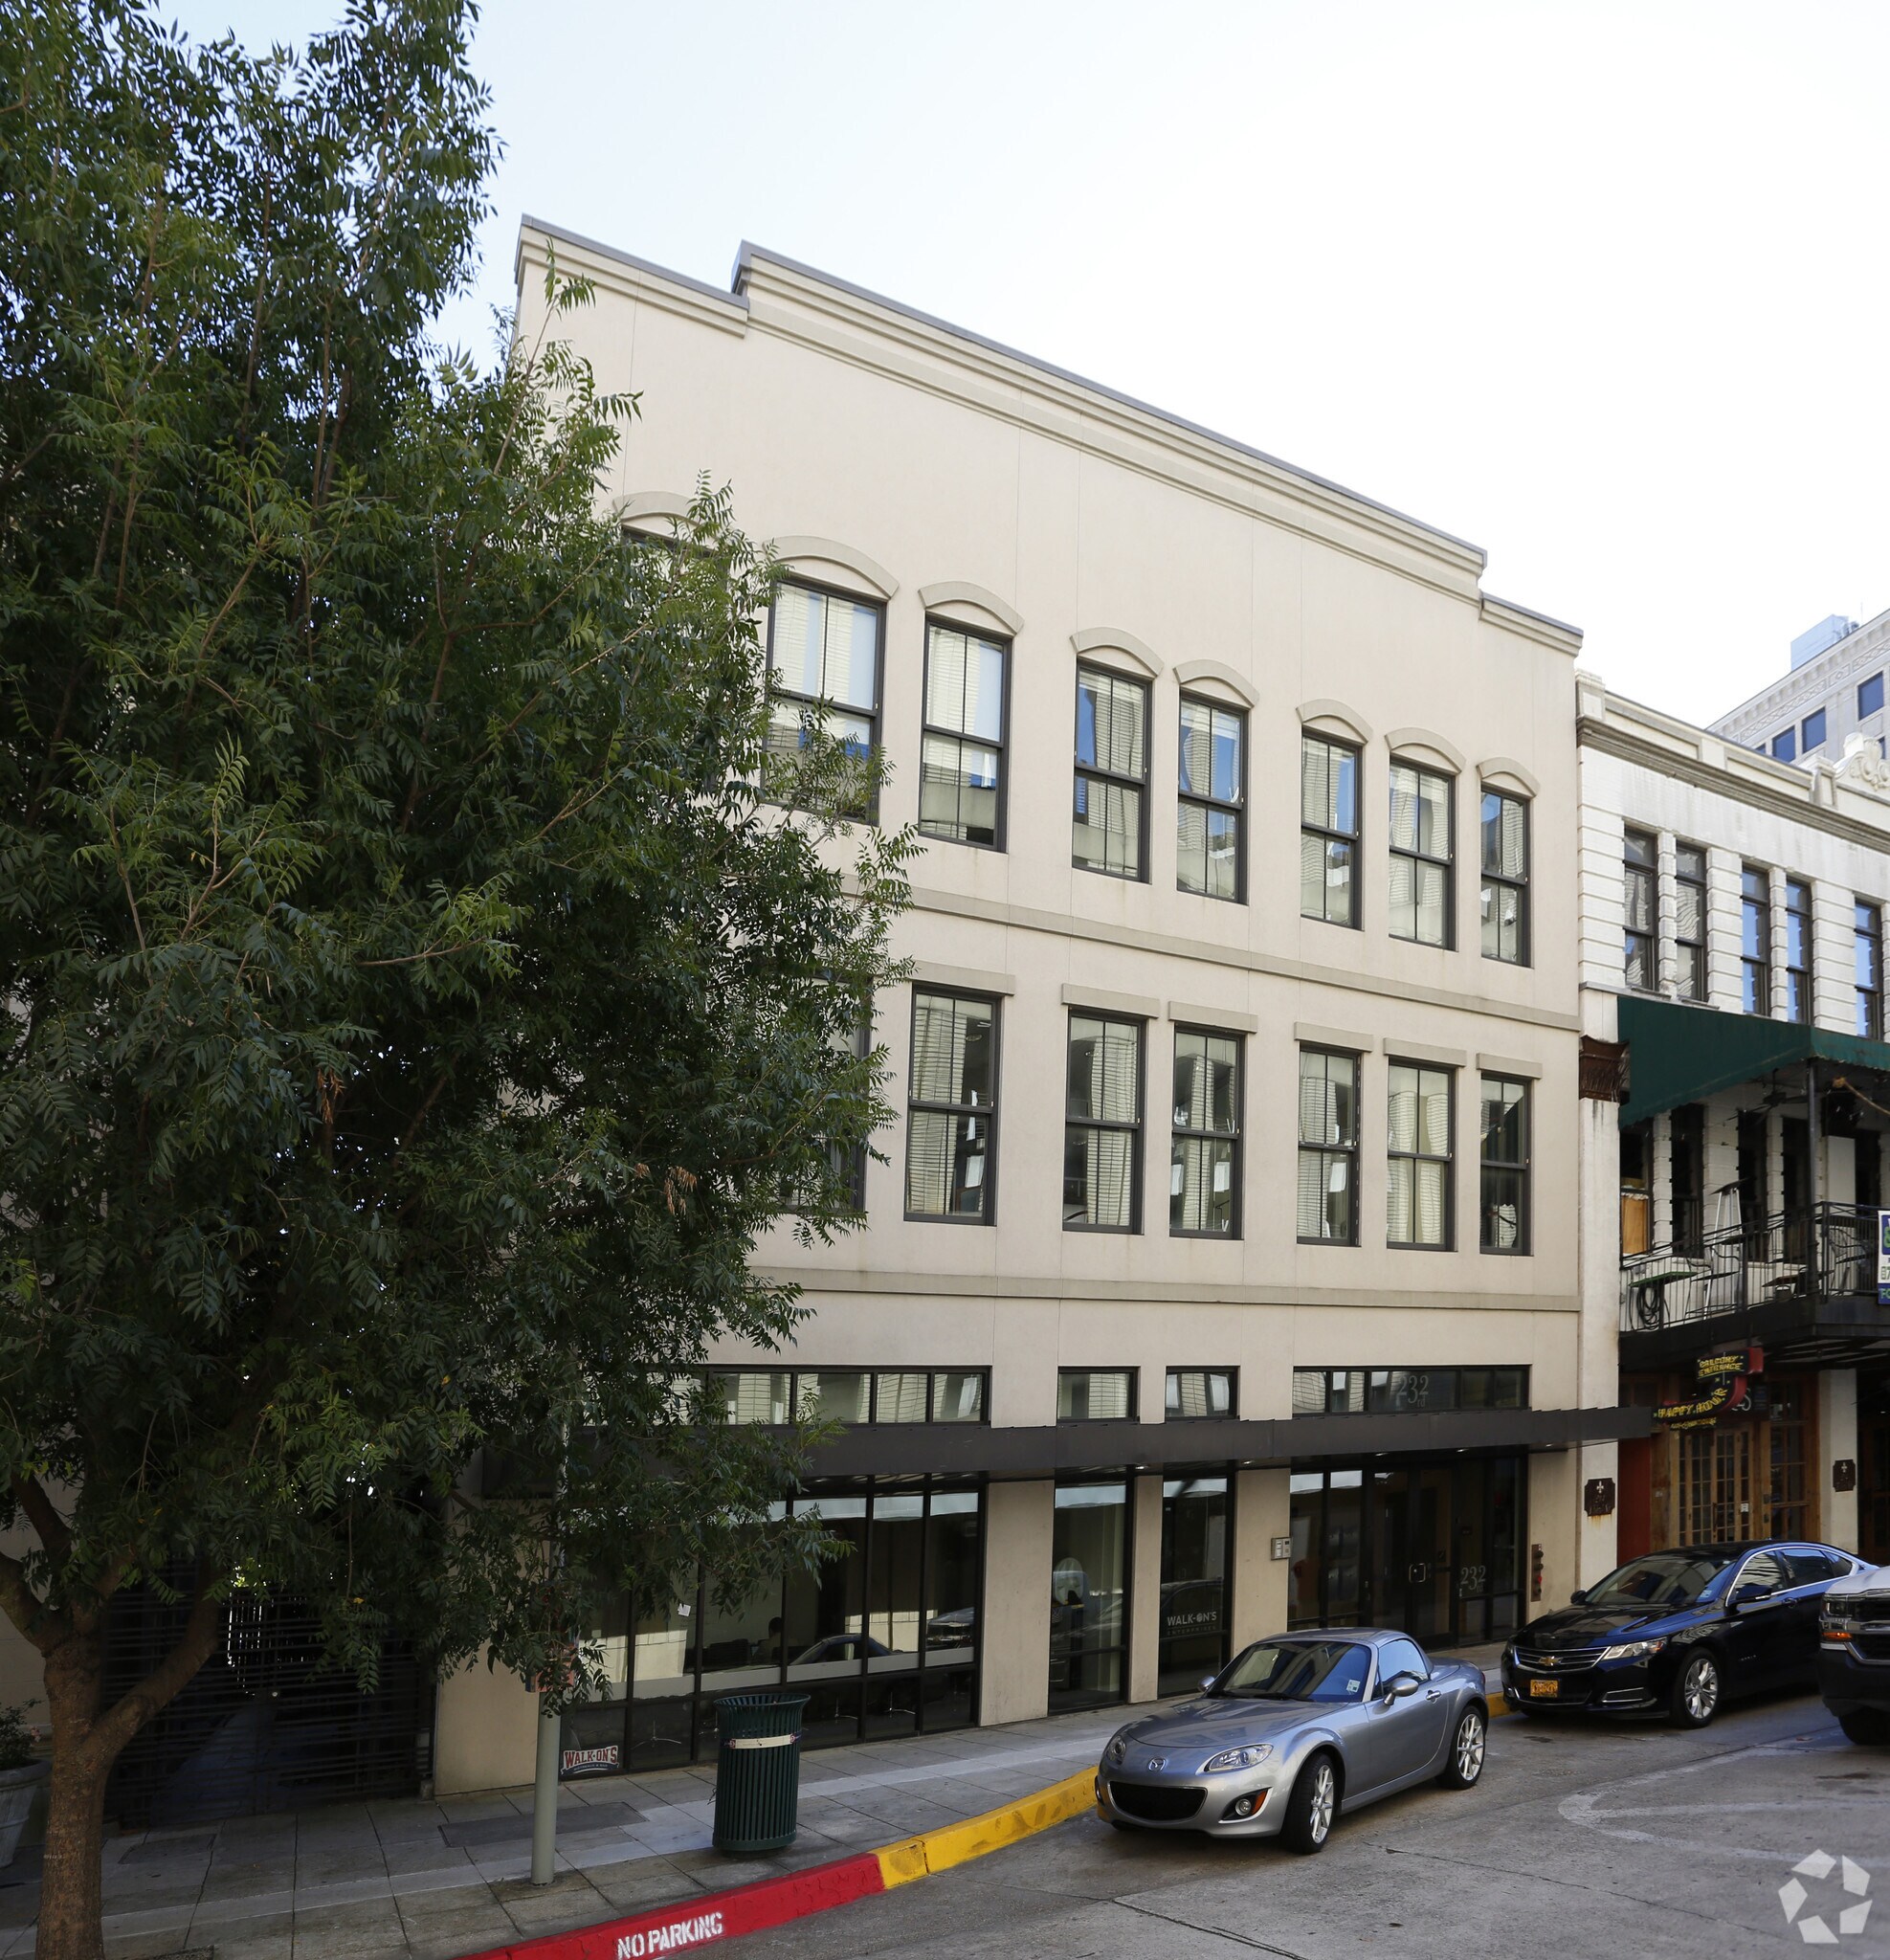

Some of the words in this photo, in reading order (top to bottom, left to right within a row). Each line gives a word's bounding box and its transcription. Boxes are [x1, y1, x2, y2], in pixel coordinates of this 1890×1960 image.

[1699, 1363, 1744, 1377] ENTRANCE
[1396, 1374, 1429, 1404] 232
[1657, 1404, 1695, 1418] HAPPY
[1696, 1388, 1728, 1414] HOUR
[1460, 1565, 1486, 1591] 232
[1167, 1611, 1217, 1627] WALK-ON'S
[617, 1933, 645, 1960] NO
[648, 1912, 723, 1954] PARKING
